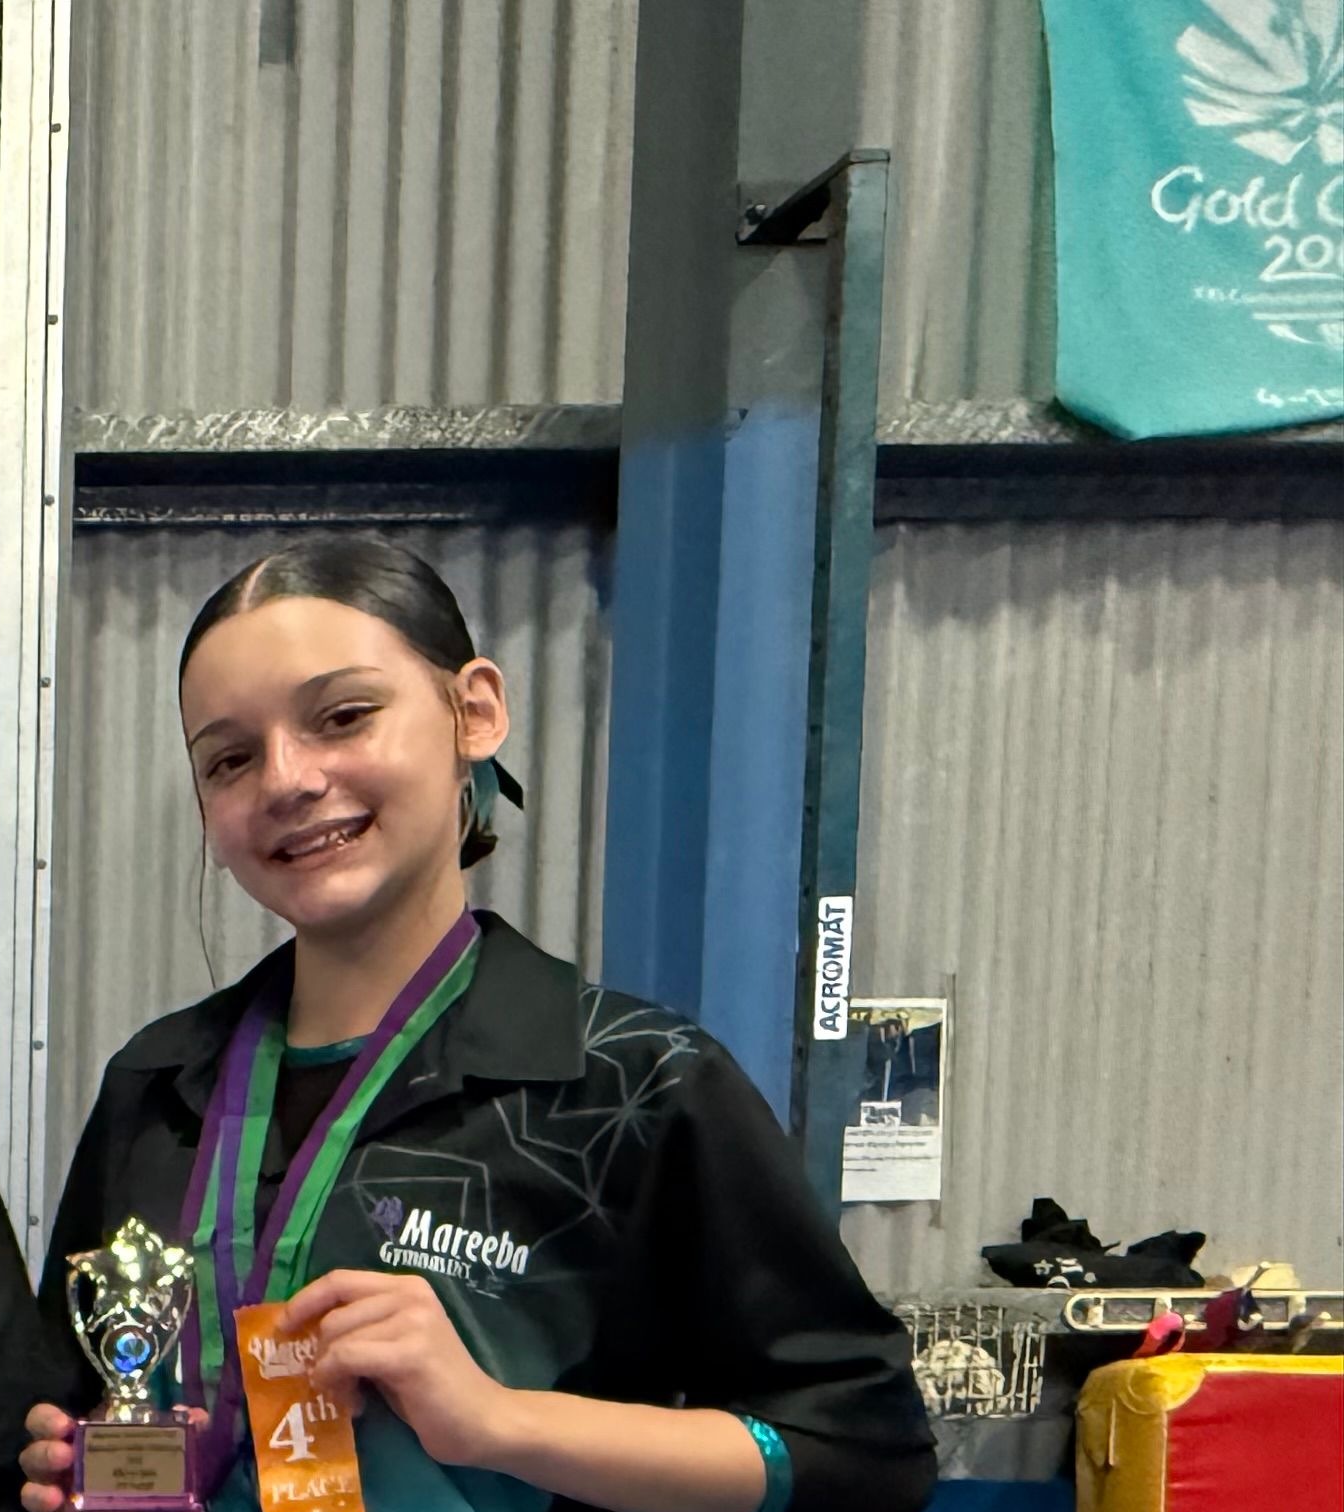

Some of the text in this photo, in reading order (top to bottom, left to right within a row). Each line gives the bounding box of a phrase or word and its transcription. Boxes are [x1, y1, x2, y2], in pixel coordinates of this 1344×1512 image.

[1150, 164, 1304, 233] Gold
[1259, 234, 1344, 282] 20
[819, 903, 846, 1032] ACROMAT
[399, 1208, 529, 1275] Mareeba
[269, 1393, 339, 1462] 4th
